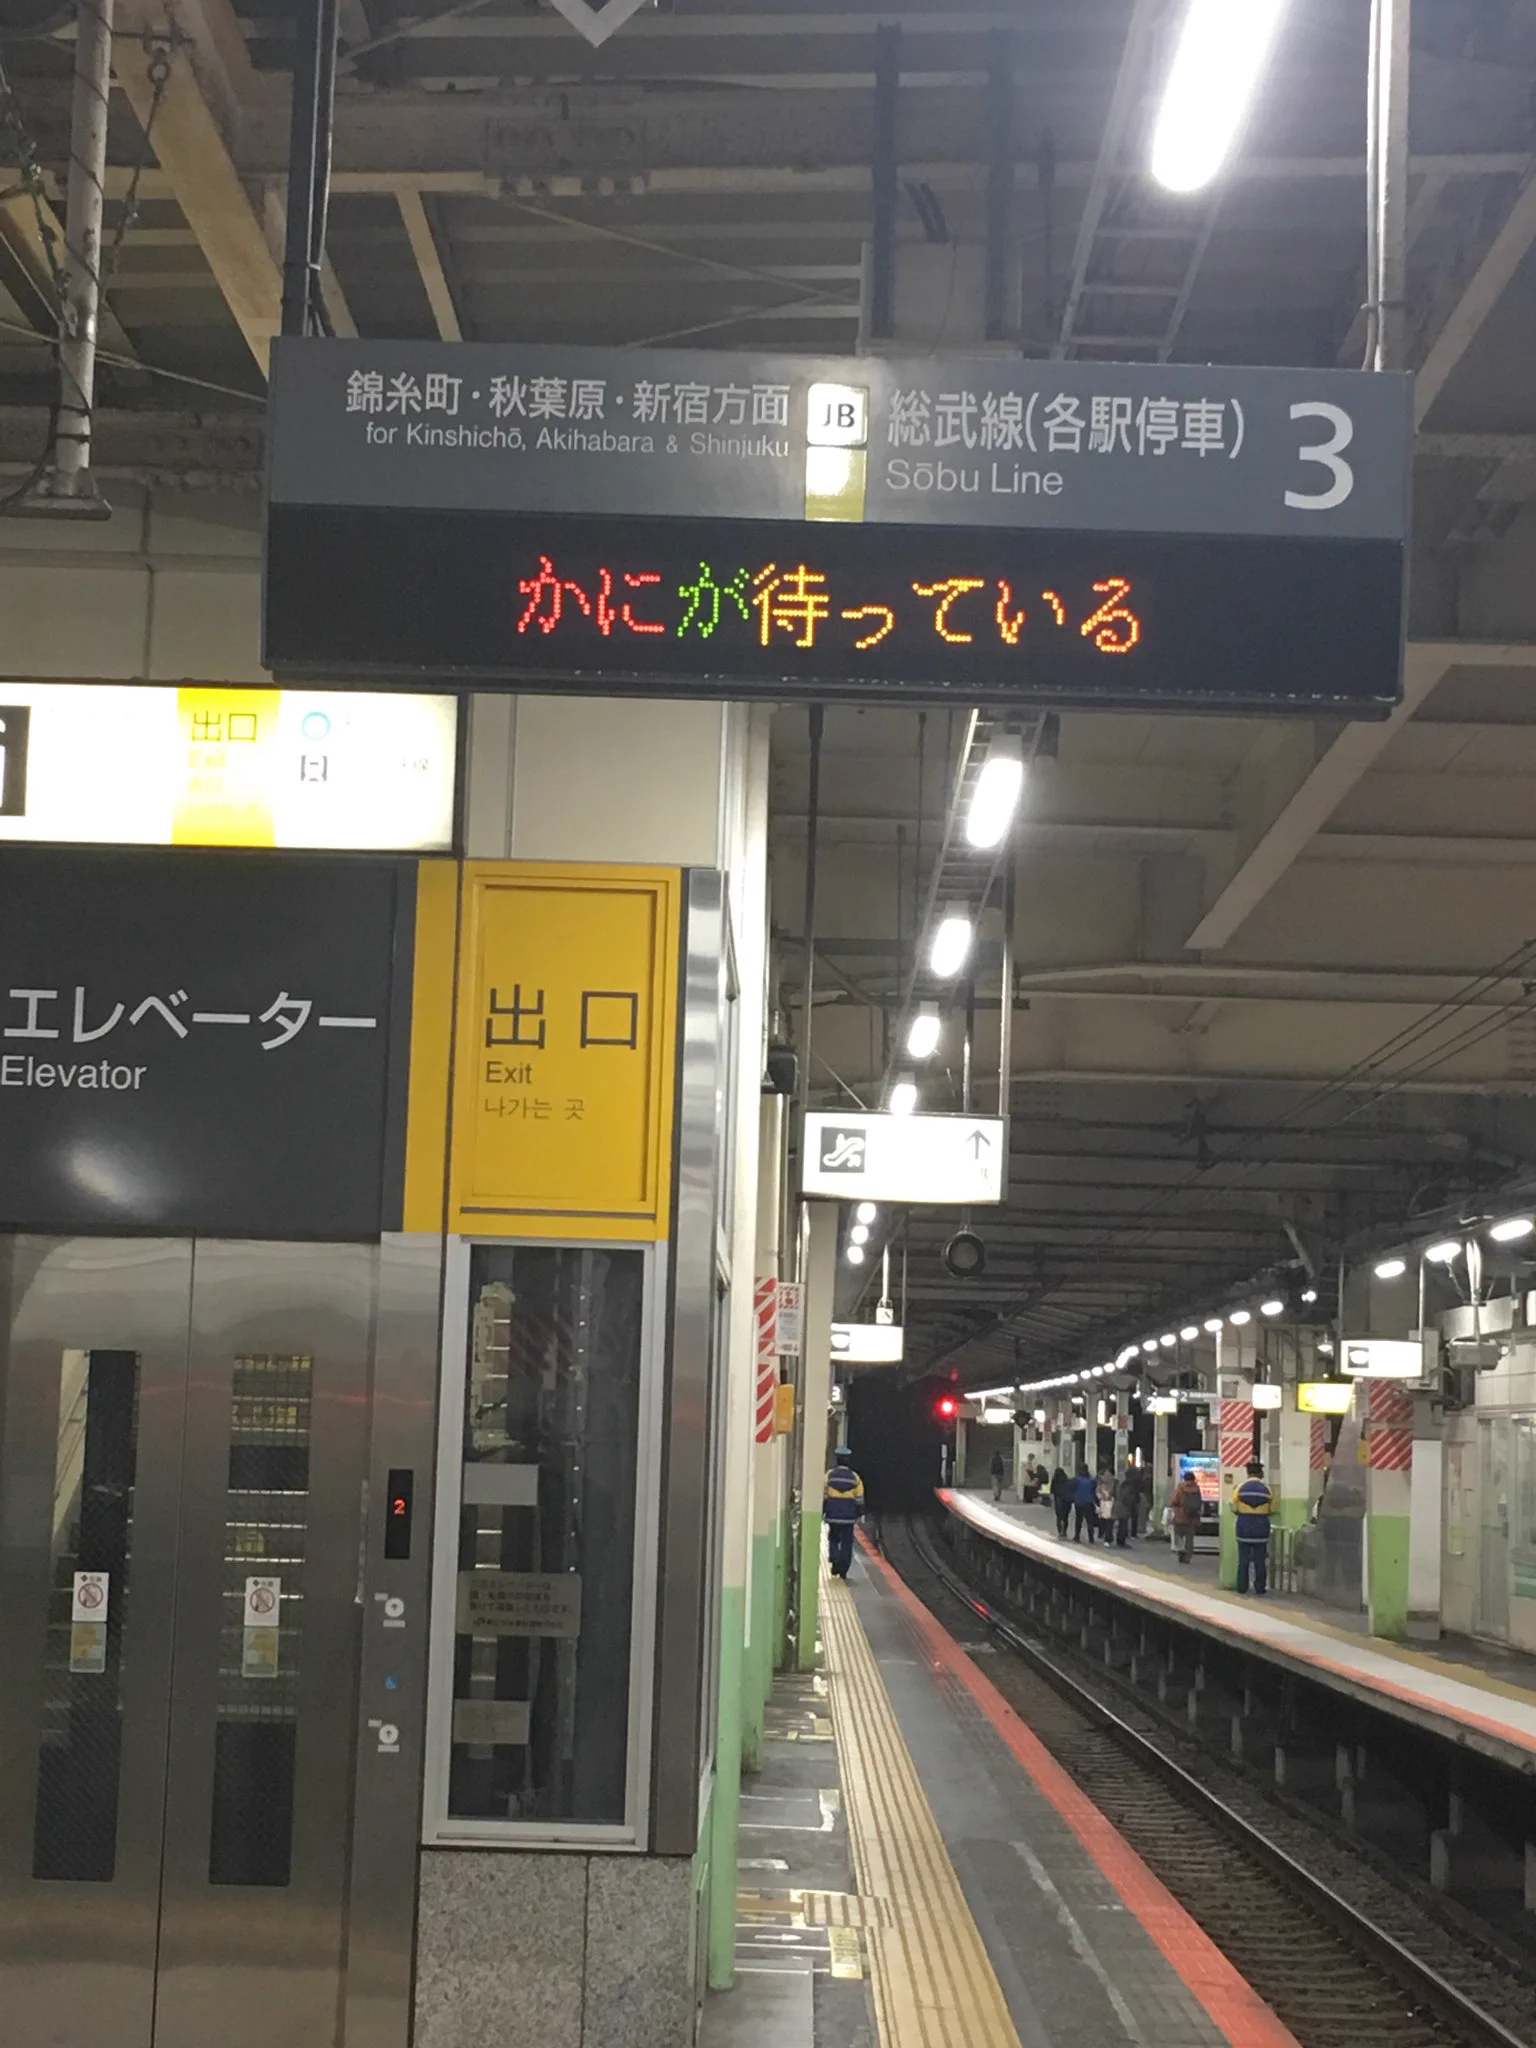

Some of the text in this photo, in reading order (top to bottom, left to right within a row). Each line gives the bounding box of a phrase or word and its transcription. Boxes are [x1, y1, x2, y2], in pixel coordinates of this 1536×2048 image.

[345, 369, 791, 427] 錦糸町・秋葉原・新宿方面
[821, 402, 856, 428] JB
[366, 421, 790, 460] for Kinshichō, Akihabara & Shinjuku
[887, 390, 1246, 460] 総武線(各駅停車)
[1284, 401, 1355, 511] 3
[886, 458, 1064, 496] Sōbu Line
[191, 710, 258, 742] 出口
[3, 985, 377, 1051] エレベーター
[485, 983, 639, 1050] 出口
[0, 1054, 148, 1091] Elevator
[485, 1060, 533, 1085] Exit
[484, 1096, 586, 1121] 나가는 곳
[393, 1498, 406, 1515] 2
